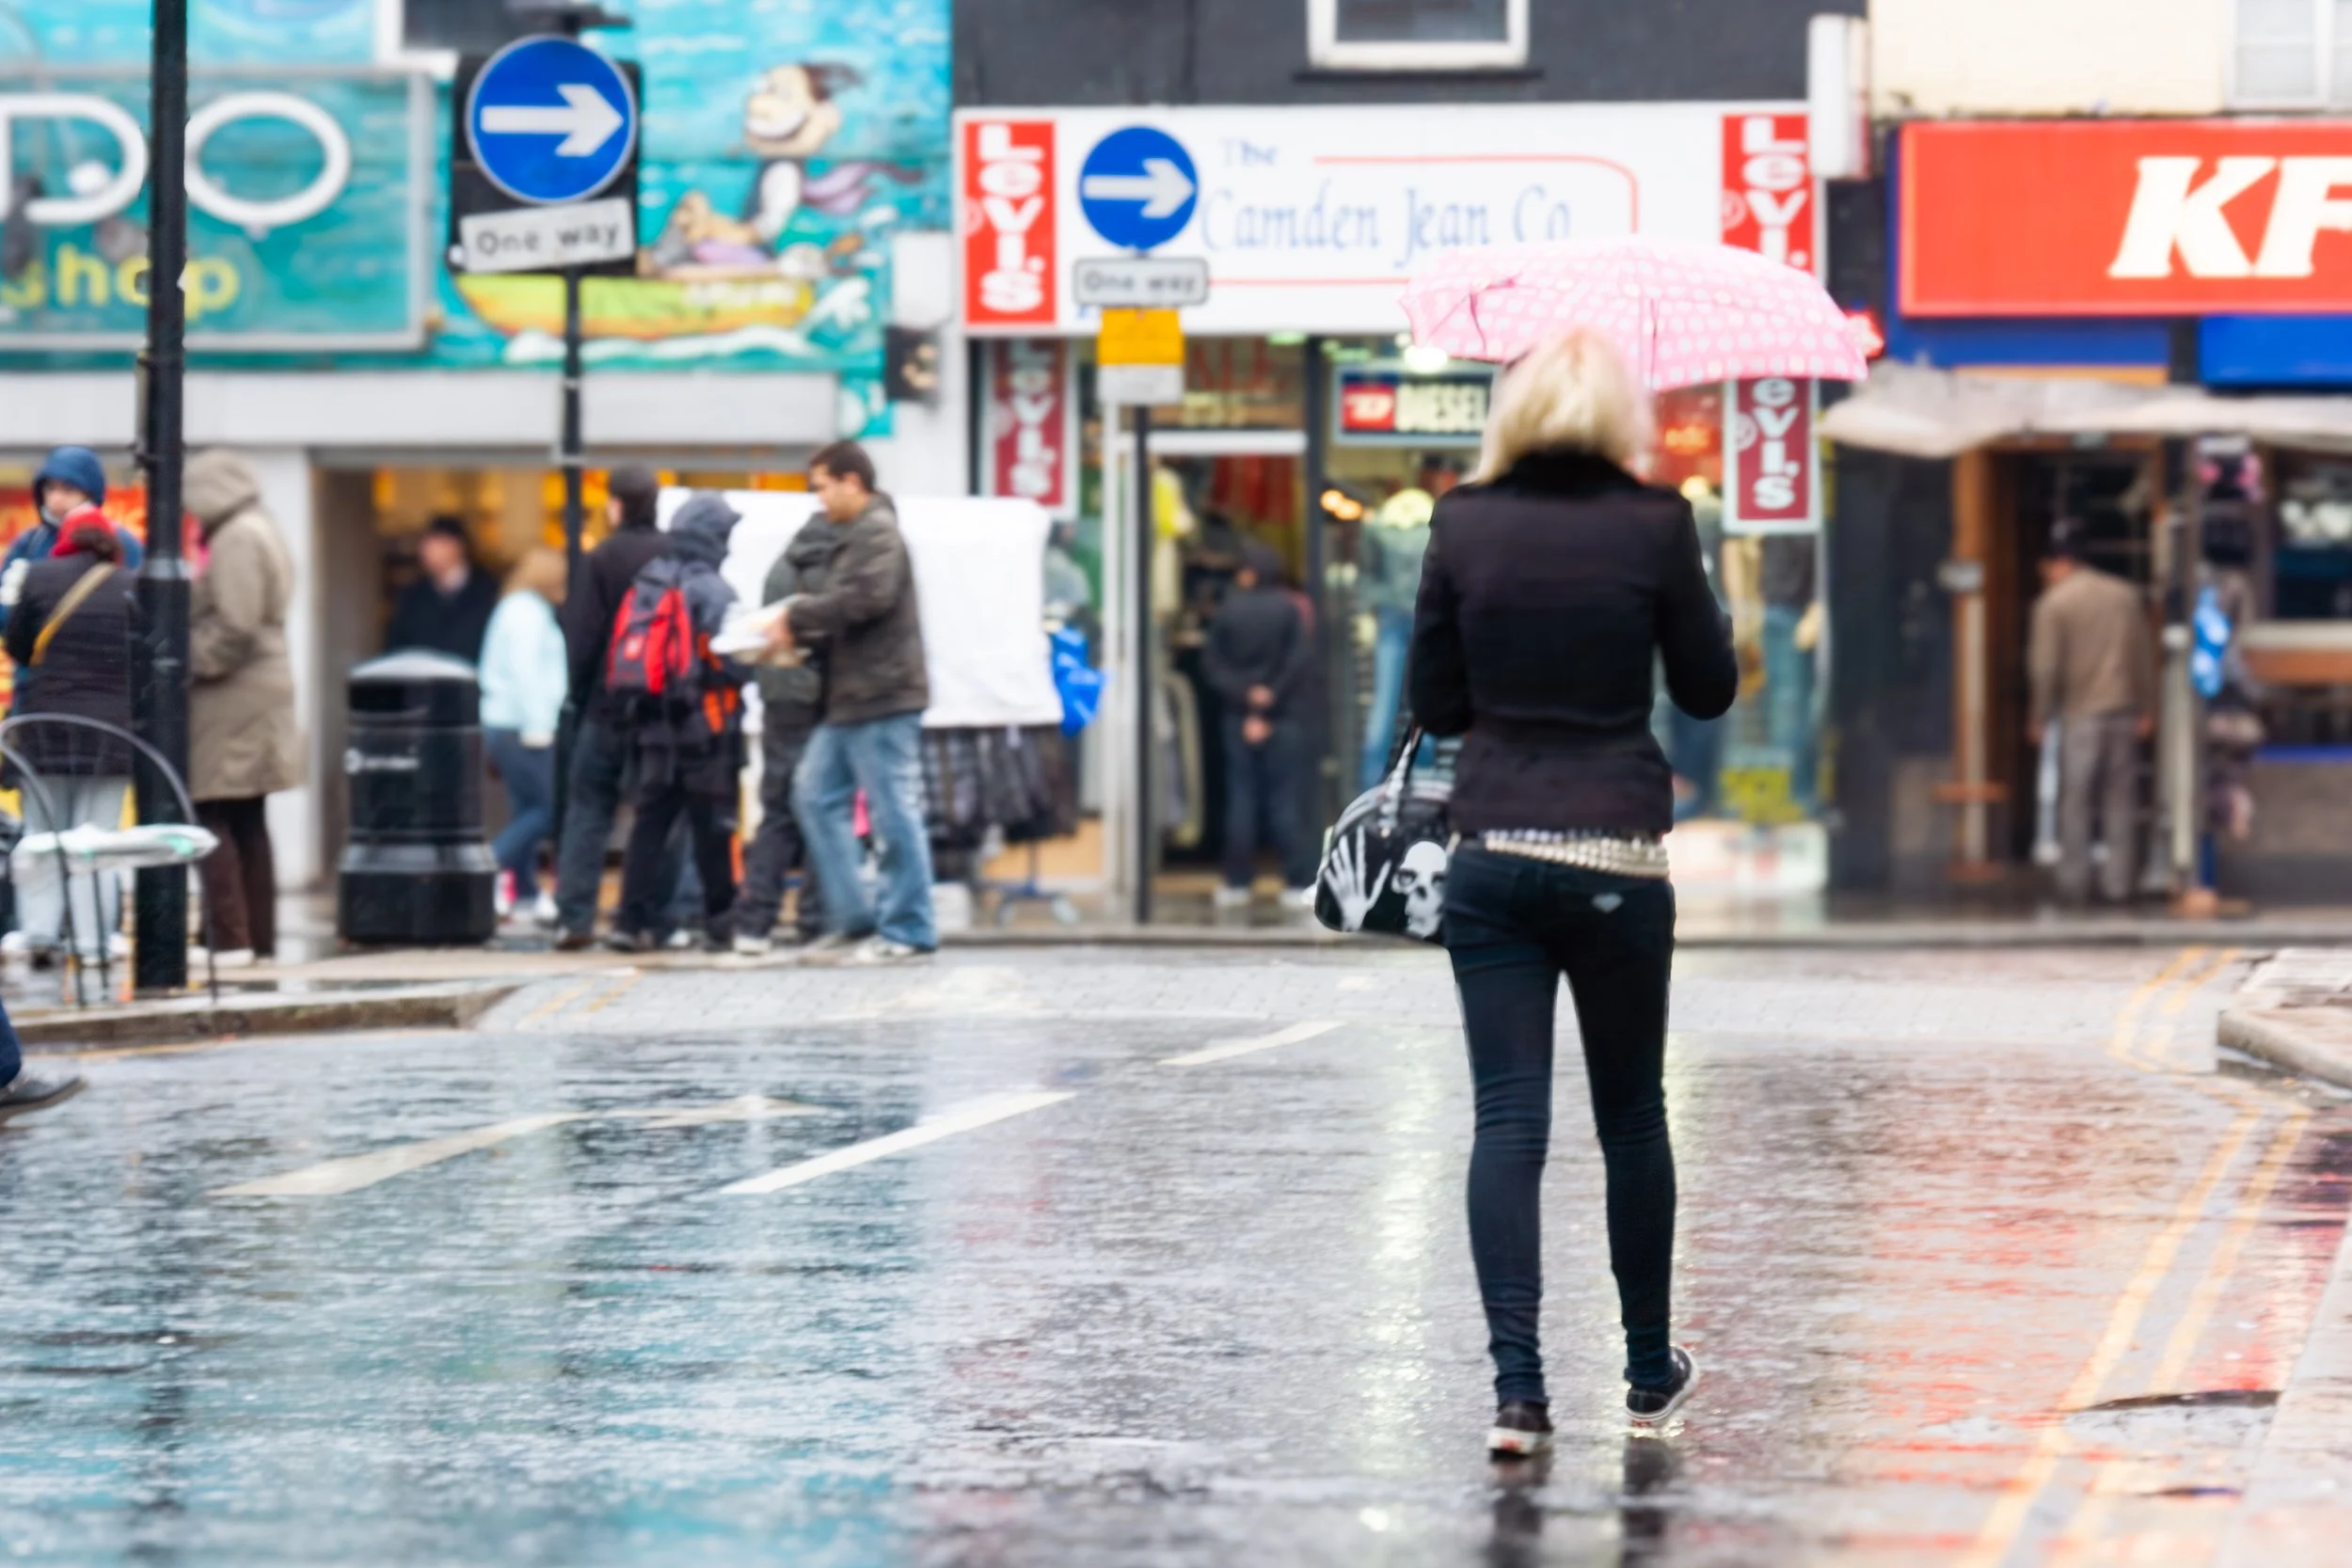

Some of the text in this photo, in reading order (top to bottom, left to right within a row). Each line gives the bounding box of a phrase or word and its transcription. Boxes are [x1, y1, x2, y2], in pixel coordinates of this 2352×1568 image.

[1220, 138, 1278, 166] The
[1200, 177, 1379, 252] Camden
[1393, 185, 1491, 269] Jean
[477, 224, 619, 257] One way
[1084, 270, 1195, 296] One way
